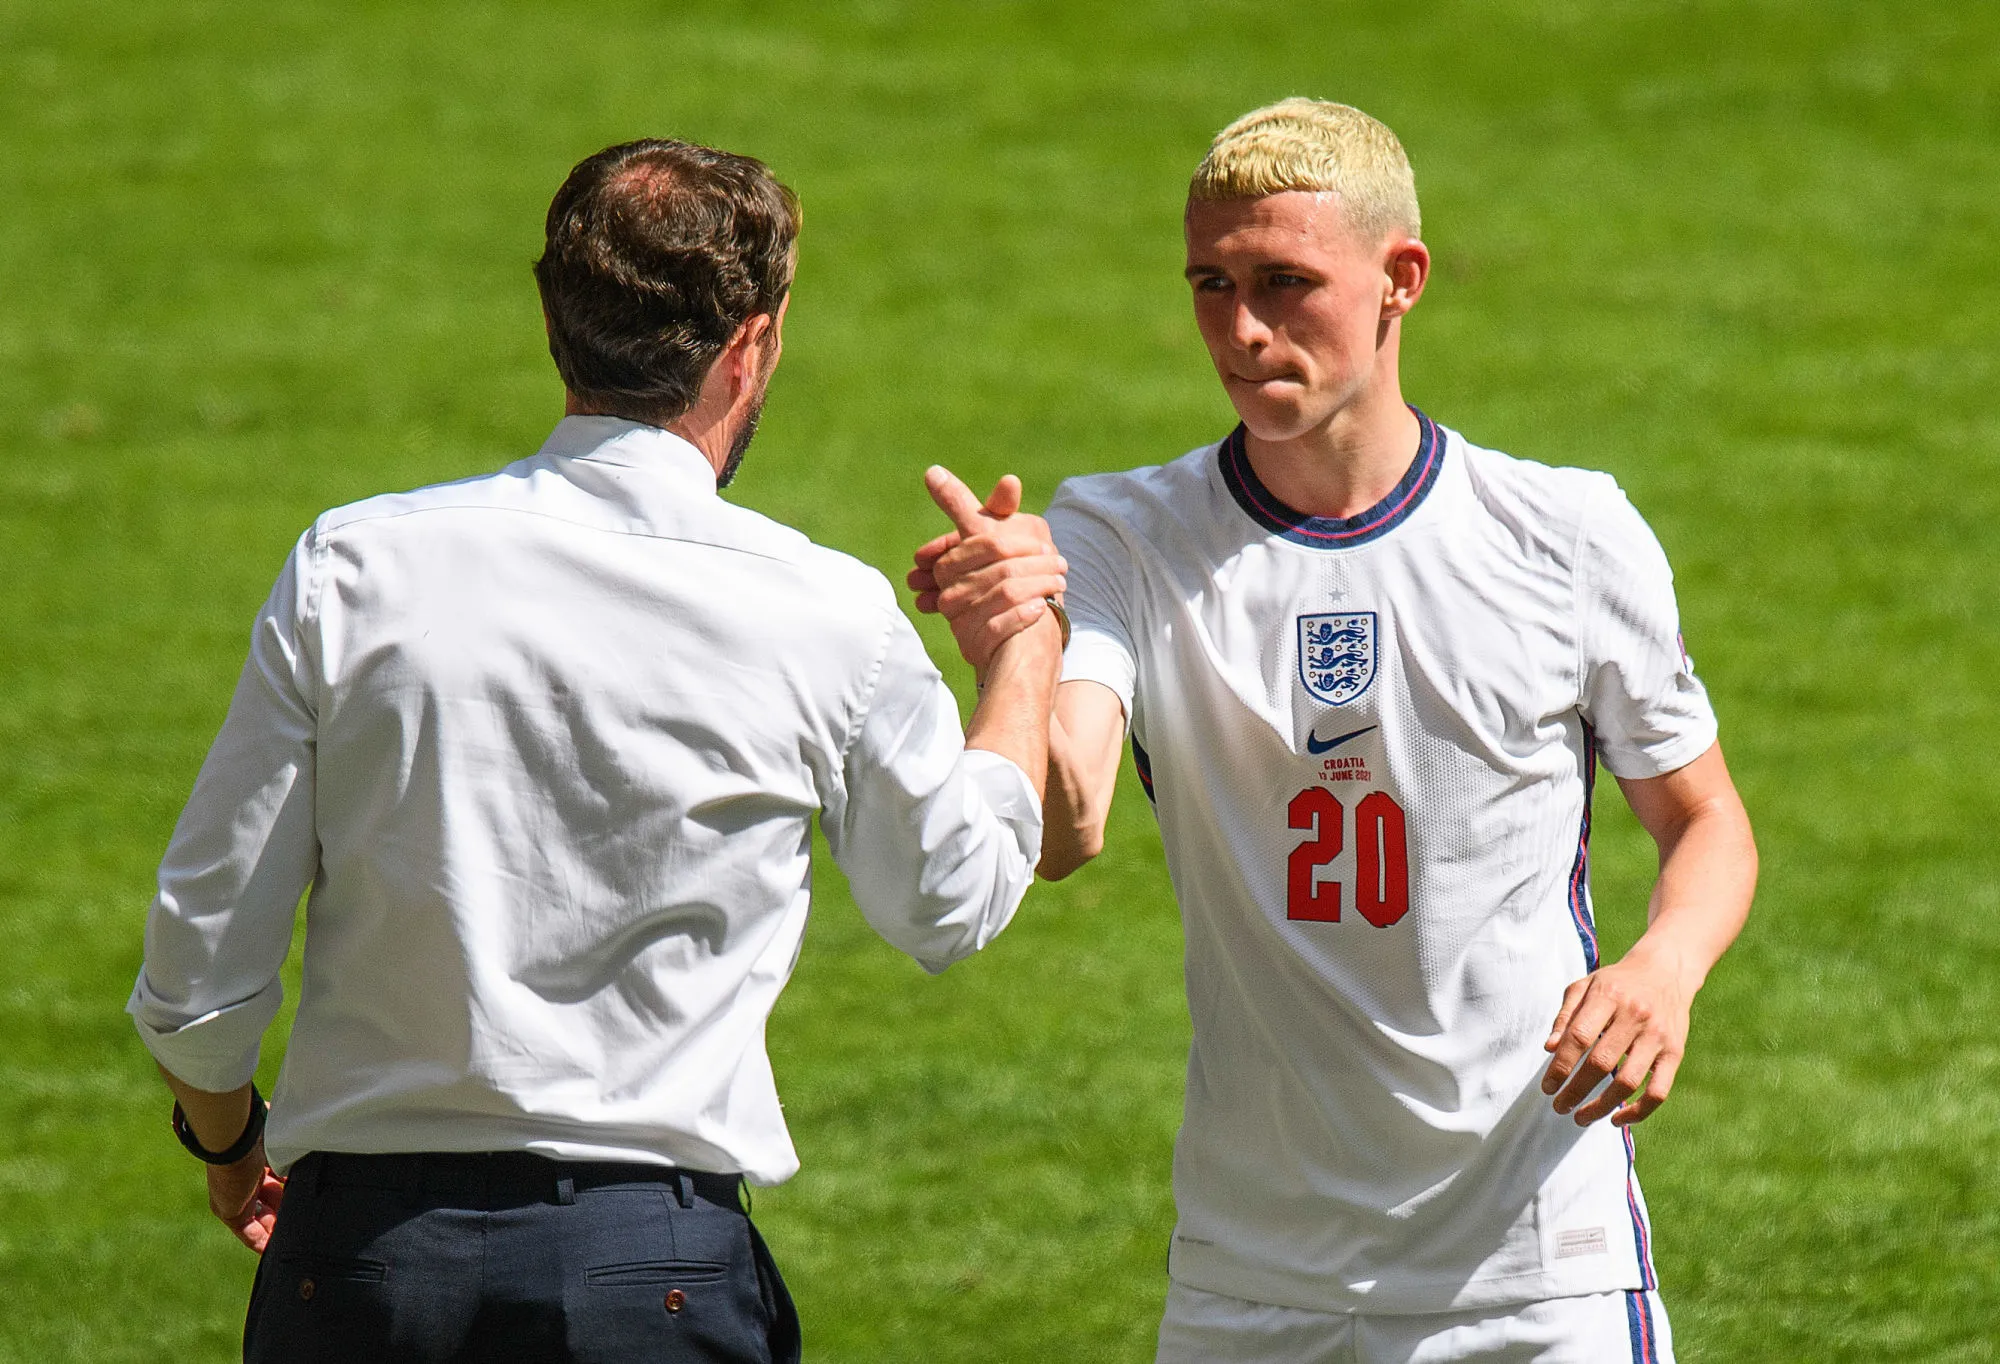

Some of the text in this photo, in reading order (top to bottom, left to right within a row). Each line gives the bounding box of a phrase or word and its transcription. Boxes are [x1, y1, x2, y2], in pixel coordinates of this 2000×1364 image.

[1324, 758, 1365, 769] CROATIA
[1318, 770, 1371, 781] 13 JUNE 2021
[1287, 786, 1409, 928] 20
